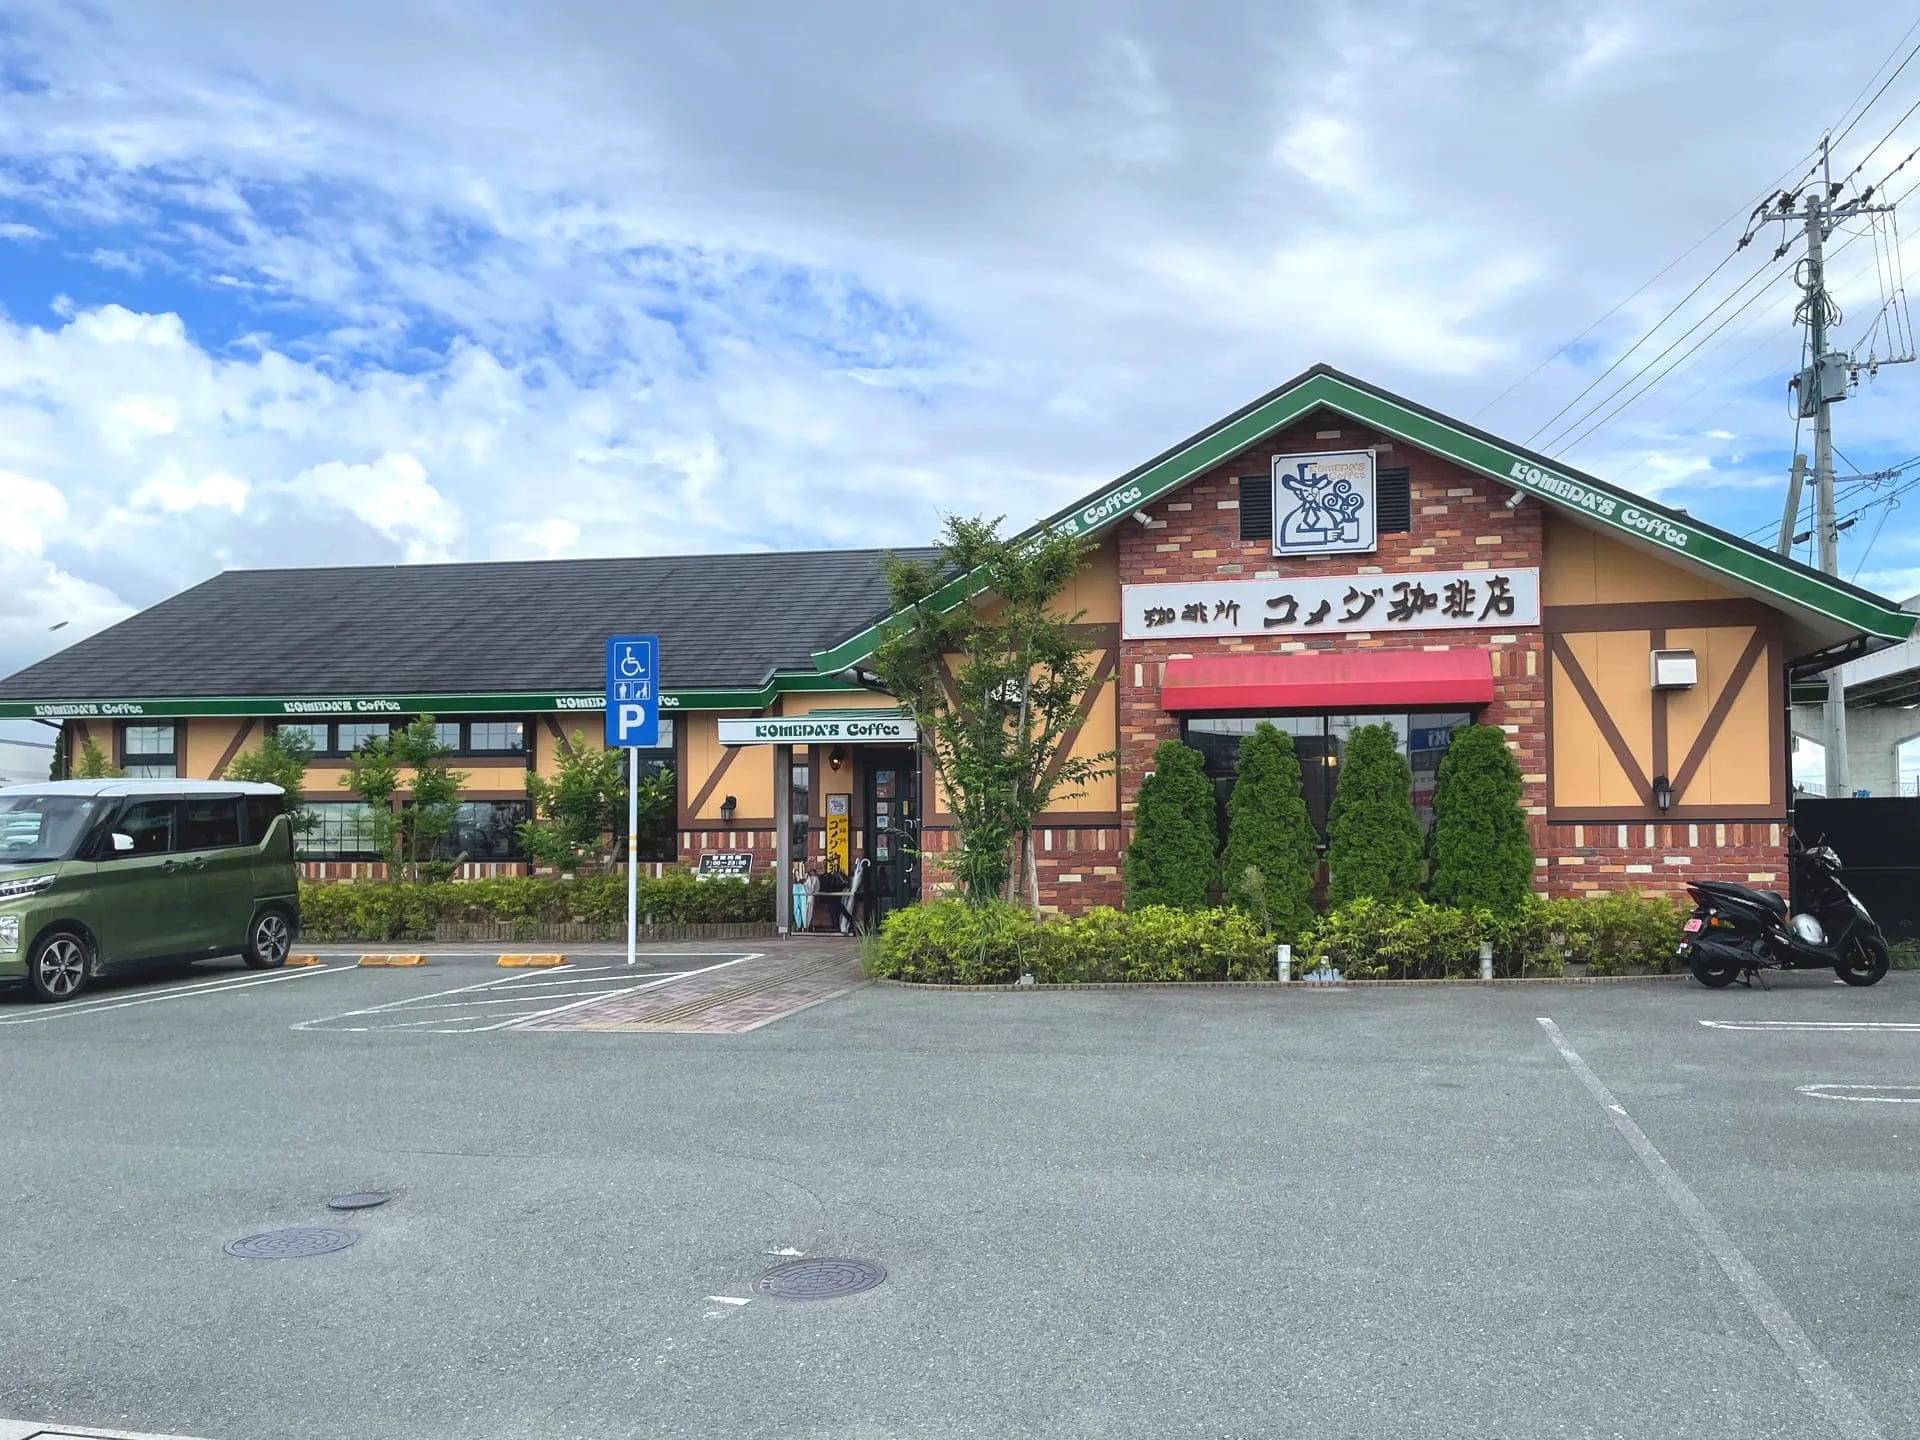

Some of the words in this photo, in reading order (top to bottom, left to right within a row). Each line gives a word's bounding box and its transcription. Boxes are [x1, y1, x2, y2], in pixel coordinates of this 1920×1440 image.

[1083, 487, 1142, 525] Coffee
[1510, 462, 1617, 516] KOMEDA'S
[1621, 509, 1688, 547] Coffee
[1144, 599, 1241, 629] 珈琲所
[1263, 575, 1516, 630] コメダ珈琲店
[34, 704, 98, 716] KOMEDA'S
[102, 703, 144, 714] Coffee
[283, 701, 353, 713] KOMEDA'S
[356, 700, 401, 712] Coffee
[556, 697, 607, 709] KOMED
[619, 704, 645, 740] P
[755, 724, 840, 738] KOMEDA'S
[846, 723, 900, 736] Coffee
